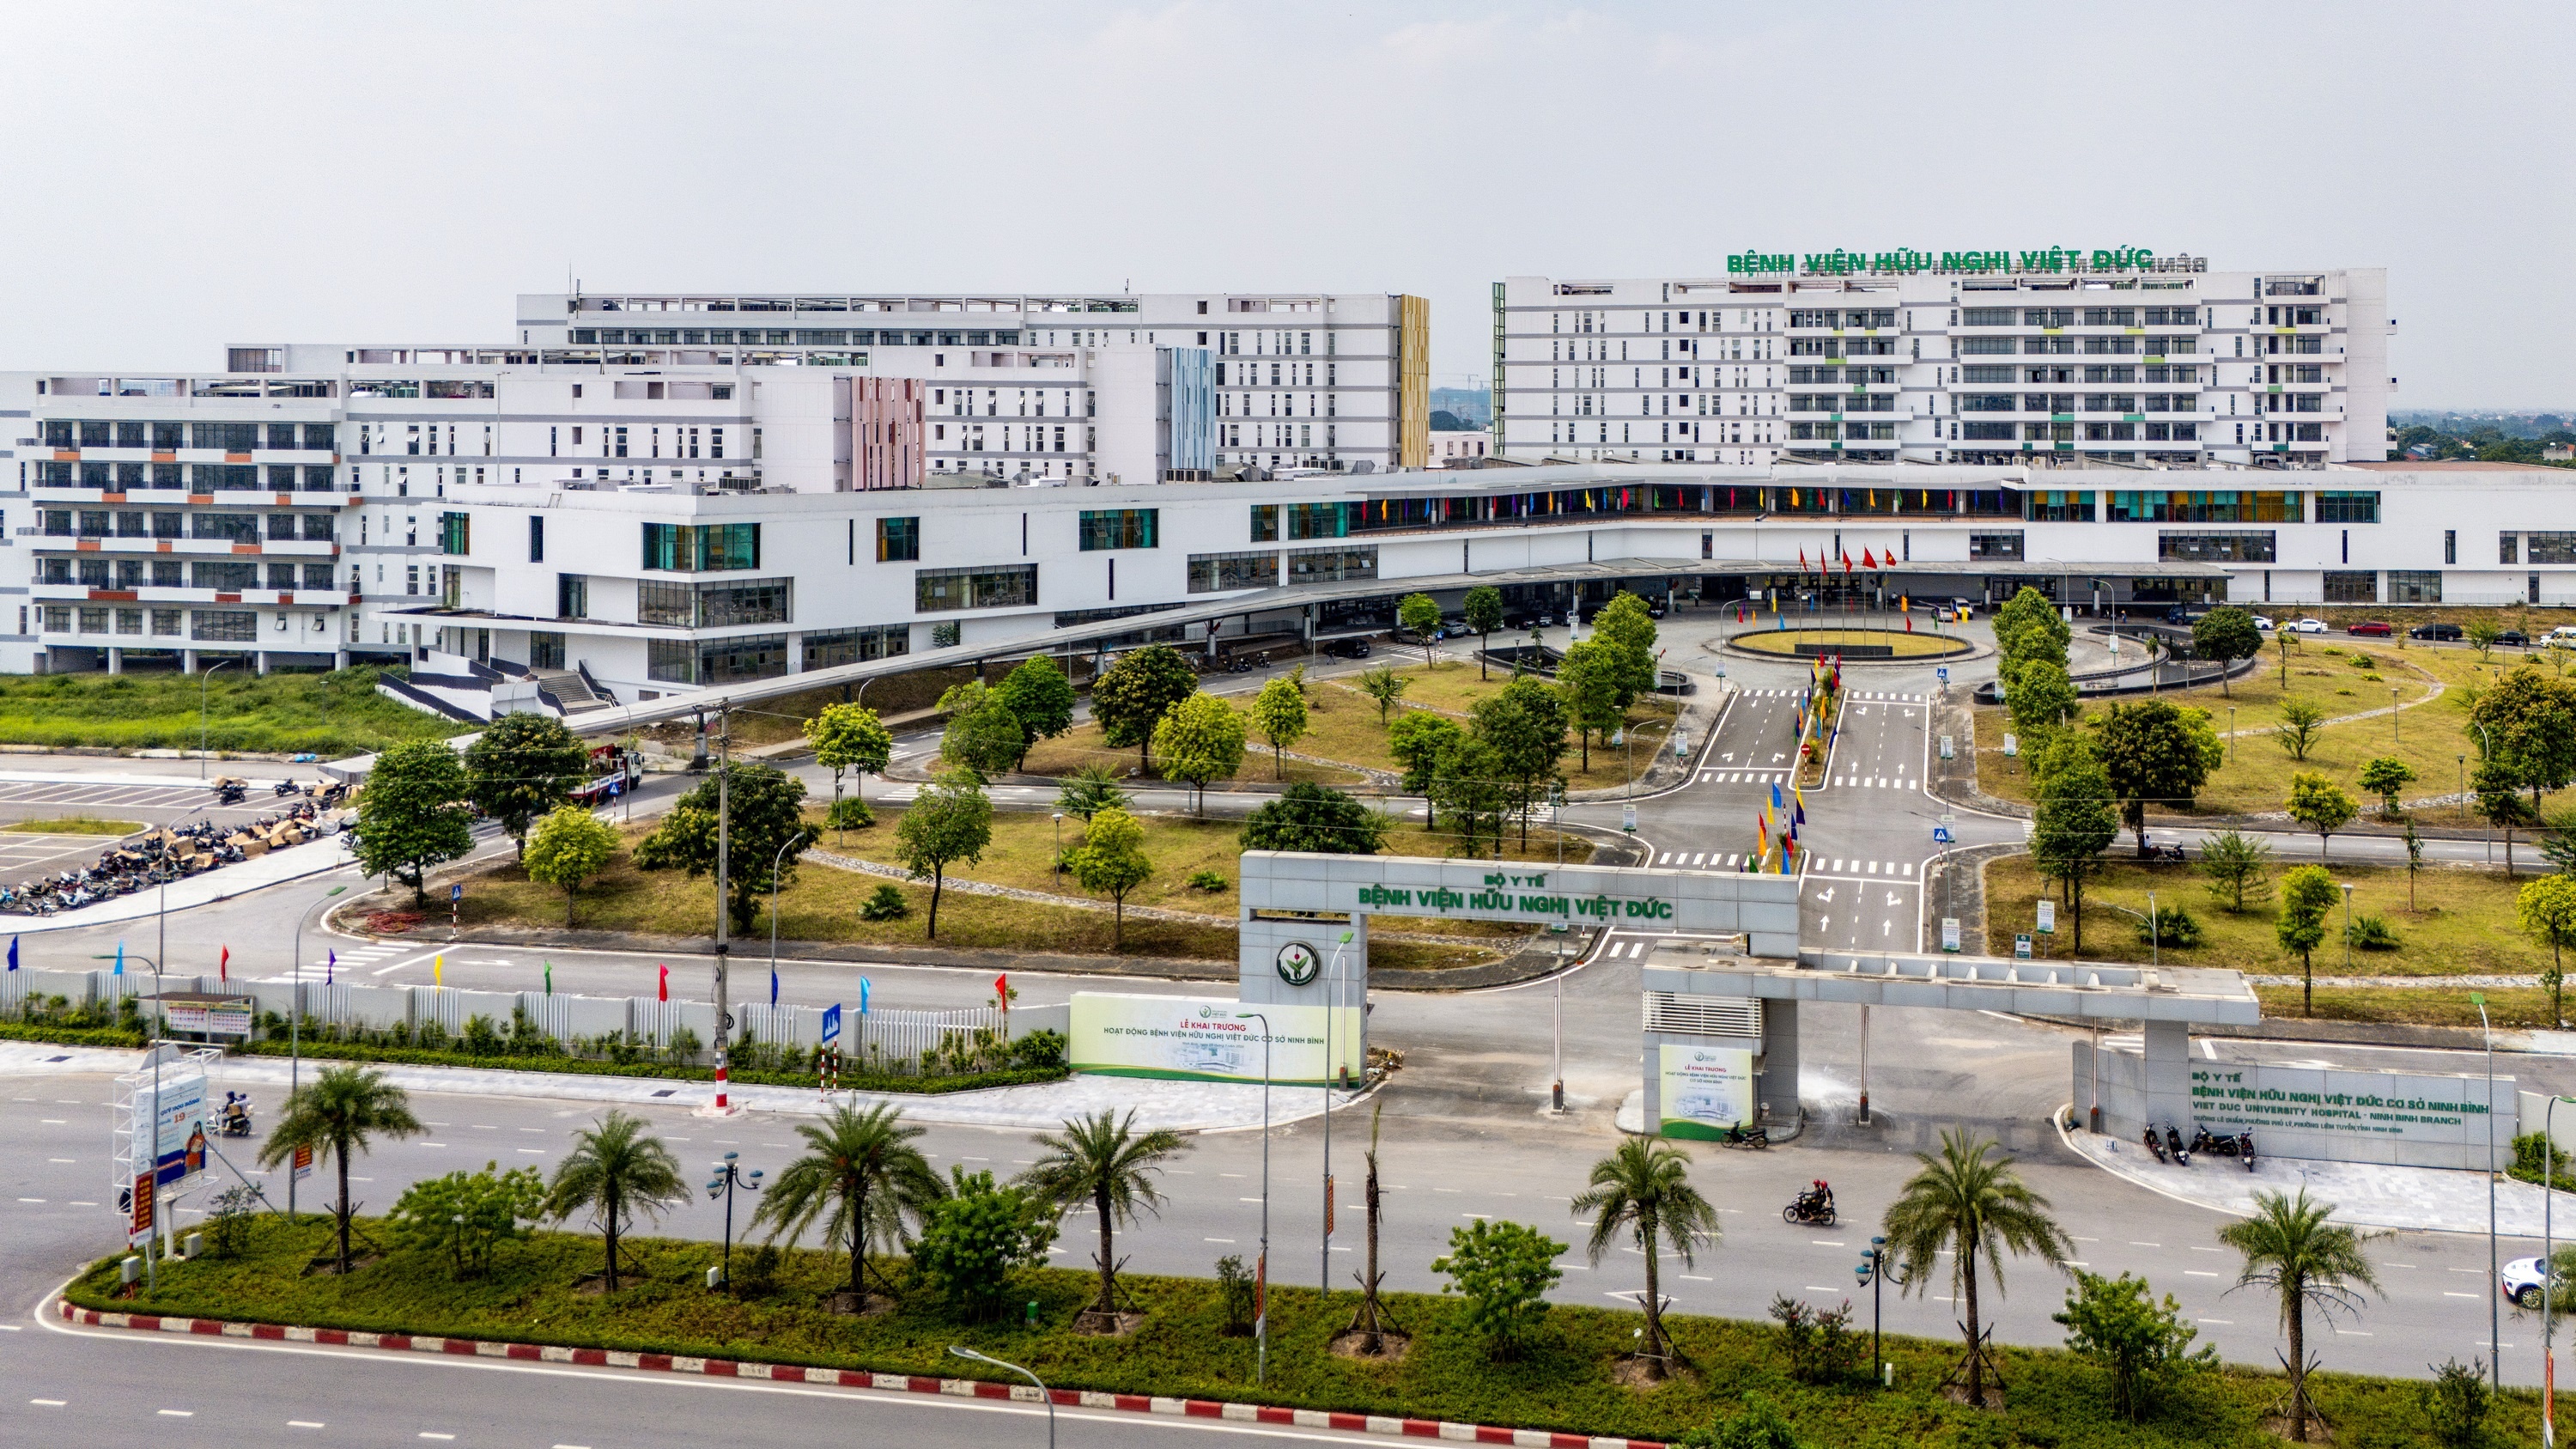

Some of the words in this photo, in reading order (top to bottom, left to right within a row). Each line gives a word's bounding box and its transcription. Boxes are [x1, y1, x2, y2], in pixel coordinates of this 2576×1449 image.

[1728, 249, 1795, 277] BỆNH
[1804, 248, 1867, 276] VIỆN
[1874, 247, 1932, 271] HỮU
[1942, 251, 2009, 275] NGHỊ
[2020, 245, 2081, 274] VIỆT
[2092, 245, 2154, 269] ĐỨC
[1484, 873, 1506, 889] BỘ
[1510, 876, 1522, 886] Y
[1525, 873, 1548, 888] TẾ
[1358, 883, 1412, 910] BỆNH
[1416, 886, 1464, 913] VIỆN
[1469, 888, 1513, 911] HỮU
[1519, 896, 1570, 919] NGHỊ
[1574, 895, 1622, 922] VIỆT
[1625, 897, 1673, 919] ĐỨC
[1126, 1027, 1148, 1037] ĐỘNG
[1151, 1028, 1169, 1038] BỆNH
[1170, 1029, 1187, 1039] VIỆN
[1206, 1032, 1224, 1042] NGHỊ
[1226, 1032, 1242, 1042] VIỆT
[1243, 1033, 1260, 1042] ĐỨC
[1307, 1036, 1325, 1044] BÌNH
[1191, 1021, 1210, 1030] KHAI
[1212, 1022, 1247, 1032] TRƯƠNG
[2192, 1070, 2209, 1082] BỘ
[2213, 1073, 2222, 1081] Y
[2225, 1072, 2243, 1082] TẾ
[2192, 1085, 2224, 1099] BỆNH
[2227, 1087, 2256, 1100] VIỆN
[2259, 1088, 2286, 1101] HỮU
[2289, 1092, 2321, 1105] NGHỊ
[2324, 1093, 2353, 1107] VIỆT
[2356, 1094, 2384, 1107] ĐỨC
[2386, 1099, 2404, 1109] CƠ
[2408, 1097, 2425, 1110] SỞ
[2428, 1101, 2458, 1112] NINH
[2460, 1100, 2489, 1114] BÌNH
[2193, 1101, 2215, 1110] VIET
[2219, 1103, 2241, 1111] DUC
[2245, 1105, 2306, 1116] UNIVERSITY
[2312, 1108, 2361, 1119] HOSPITAL
[2370, 1112, 2393, 1122] NINH
[2396, 1114, 2418, 1123] BINH
[2421, 1116, 2462, 1125] BRANCH
